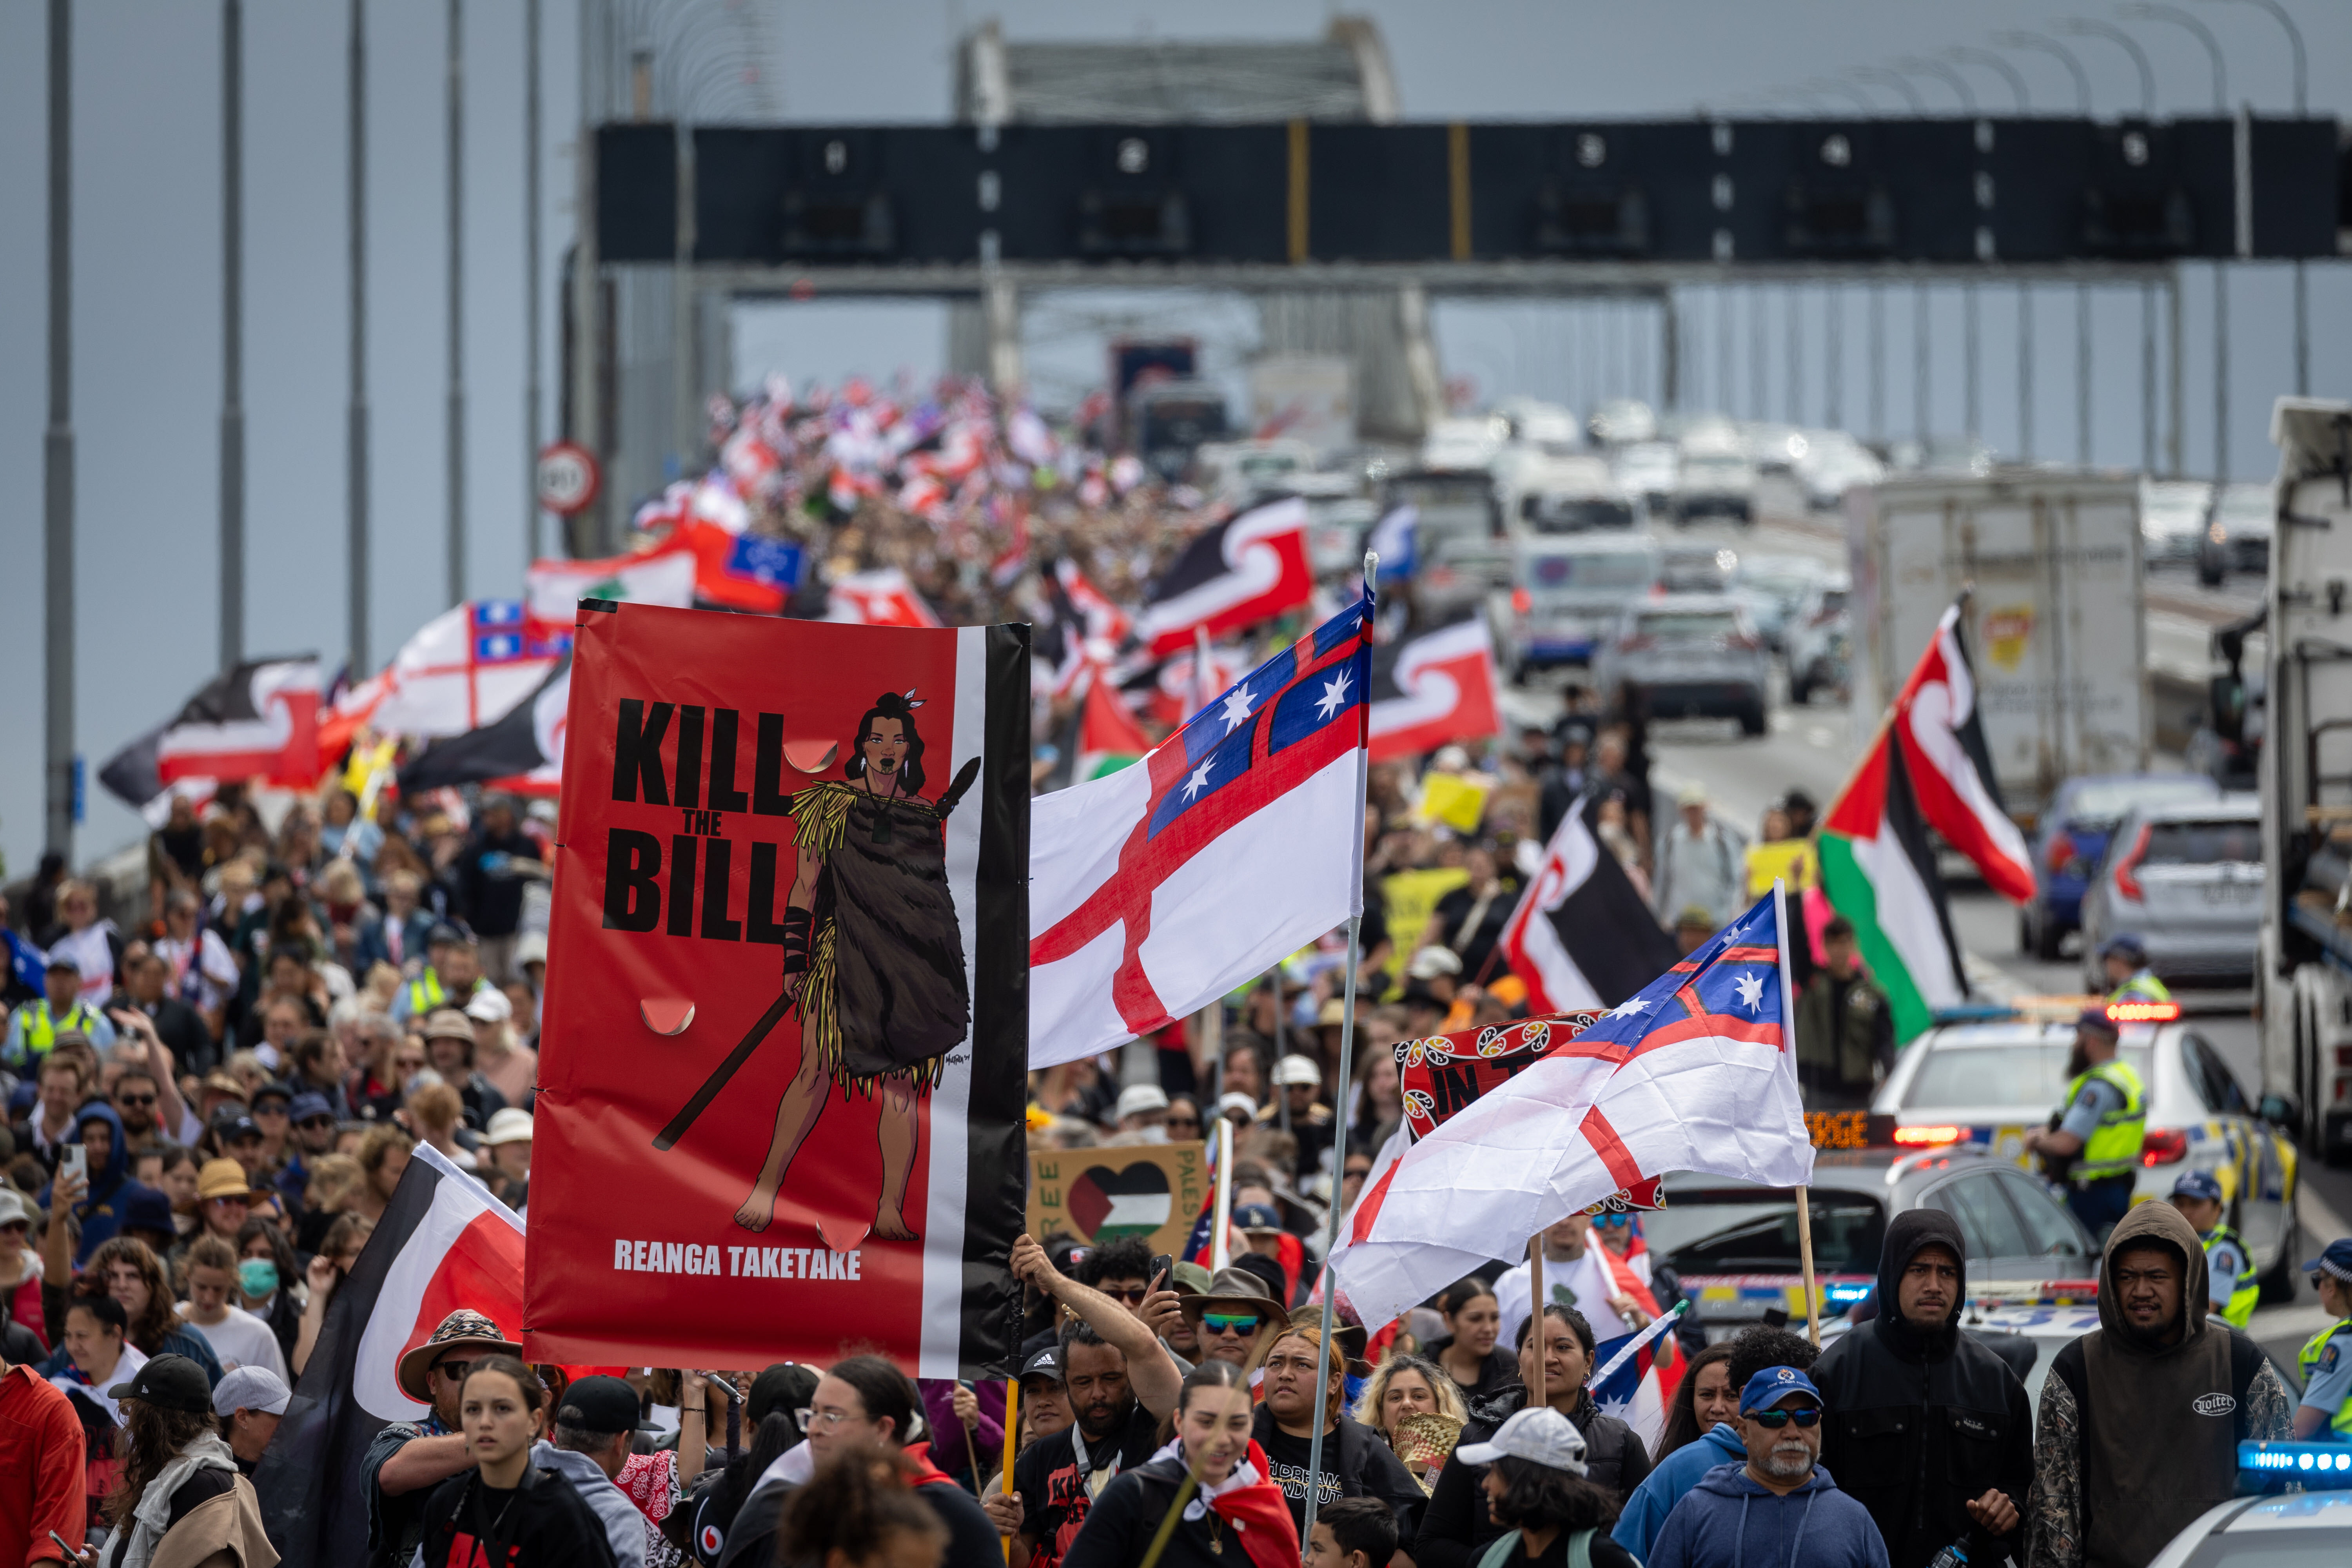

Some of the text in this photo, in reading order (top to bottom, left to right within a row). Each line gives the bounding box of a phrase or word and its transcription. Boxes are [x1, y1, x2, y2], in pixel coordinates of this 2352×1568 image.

[612, 698, 792, 817] KILL
[682, 808, 722, 837] THE
[602, 828, 785, 946] BILL
[1432, 1064, 1480, 1115] IN
[1038, 1160, 1062, 1236] REE
[614, 1239, 861, 1281] REANGA TAKETAKE
[2197, 1395, 2233, 1413] Loiter
